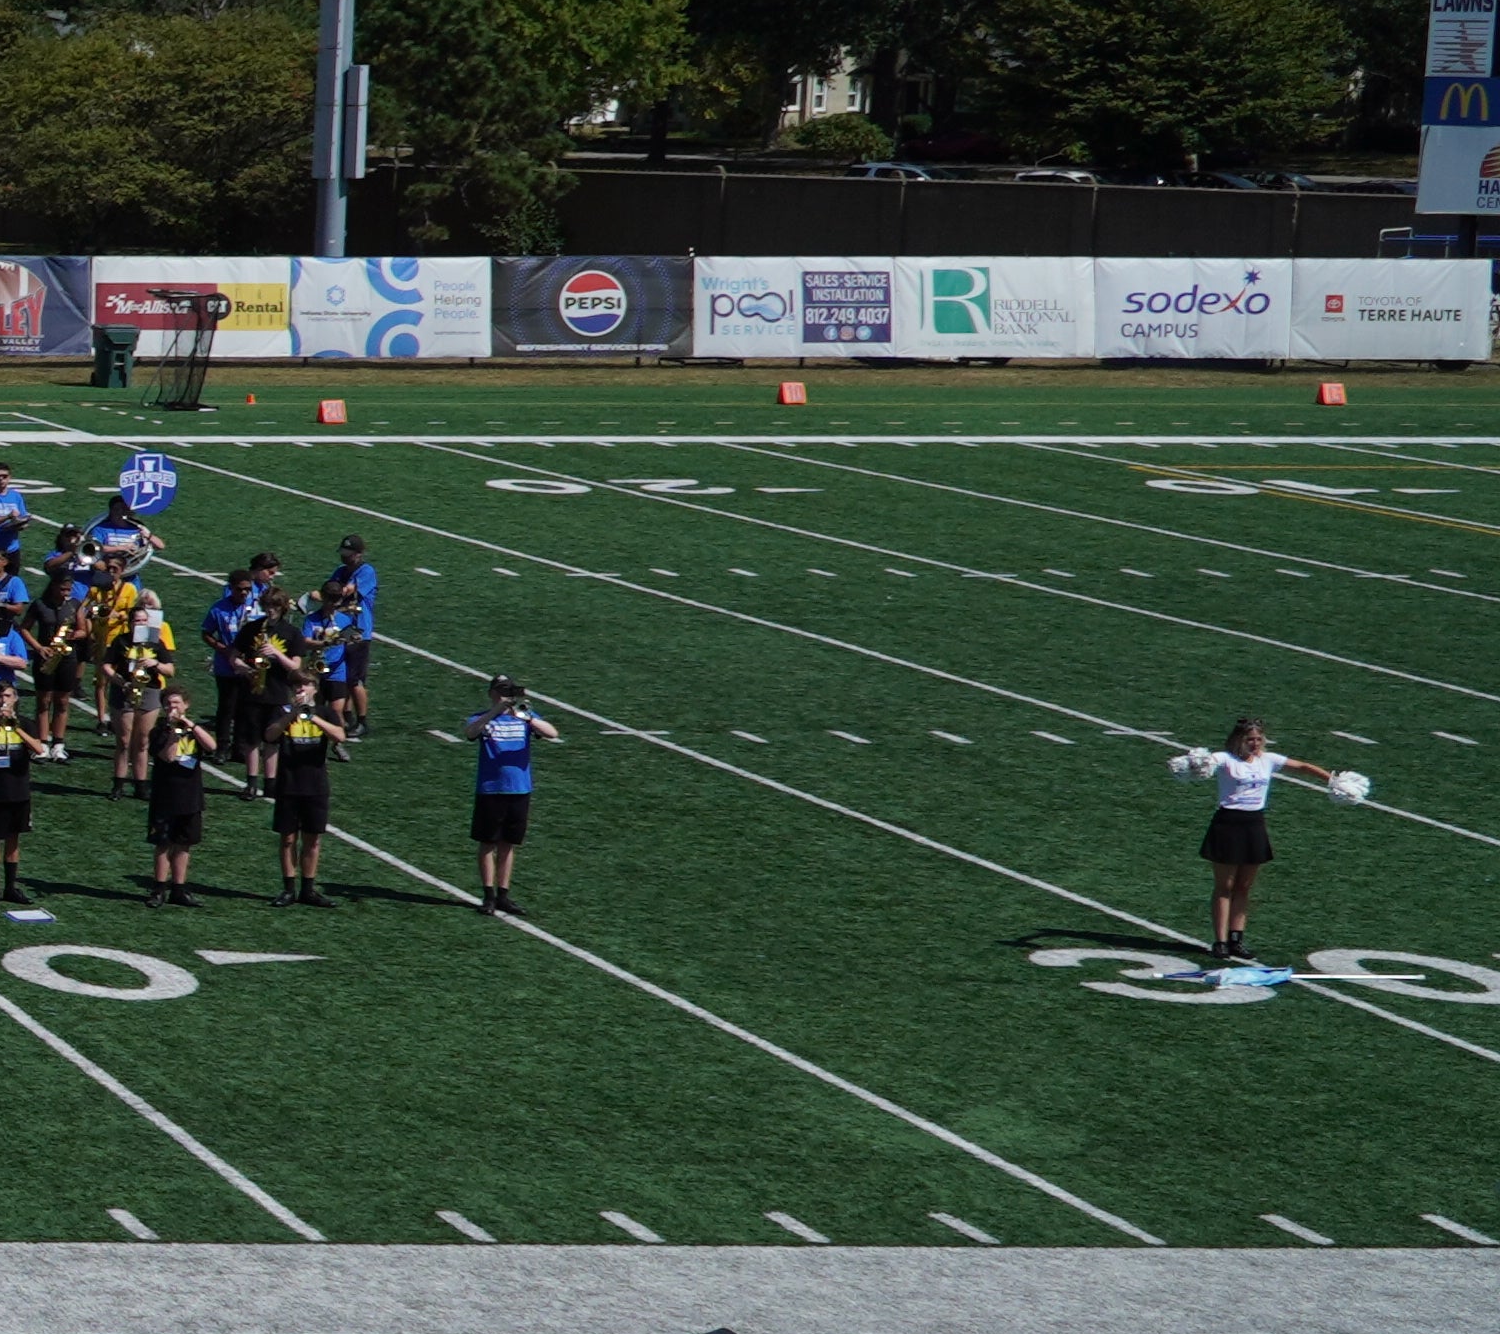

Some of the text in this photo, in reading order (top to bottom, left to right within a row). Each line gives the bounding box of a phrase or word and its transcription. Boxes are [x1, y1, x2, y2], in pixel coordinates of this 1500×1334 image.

[434, 280, 476, 292] People
[702, 277, 770, 294] Wright's
[434, 294, 482, 307] Helping
[812, 289, 884, 302] INSTALLATION
[1122, 284, 1271, 315] sodexo
[1358, 296, 1422, 307] TOYOTA OF
[234, 300, 284, 313] Rental
[564, 297, 622, 310] PEPSI
[994, 299, 1064, 310] RIDDELL
[434, 307, 480, 320] People.
[805, 308, 890, 325] 812.249.4037
[994, 311, 1076, 323] NATIONAL
[1358, 309, 1462, 321] TERRE HAUTE
[721, 325, 796, 335] SERVICE
[994, 323, 1038, 335] BANK
[1121, 323, 1198, 339] CAMPUS
[323, 400, 344, 422] 20
[1028, 948, 1500, 1005] 30
